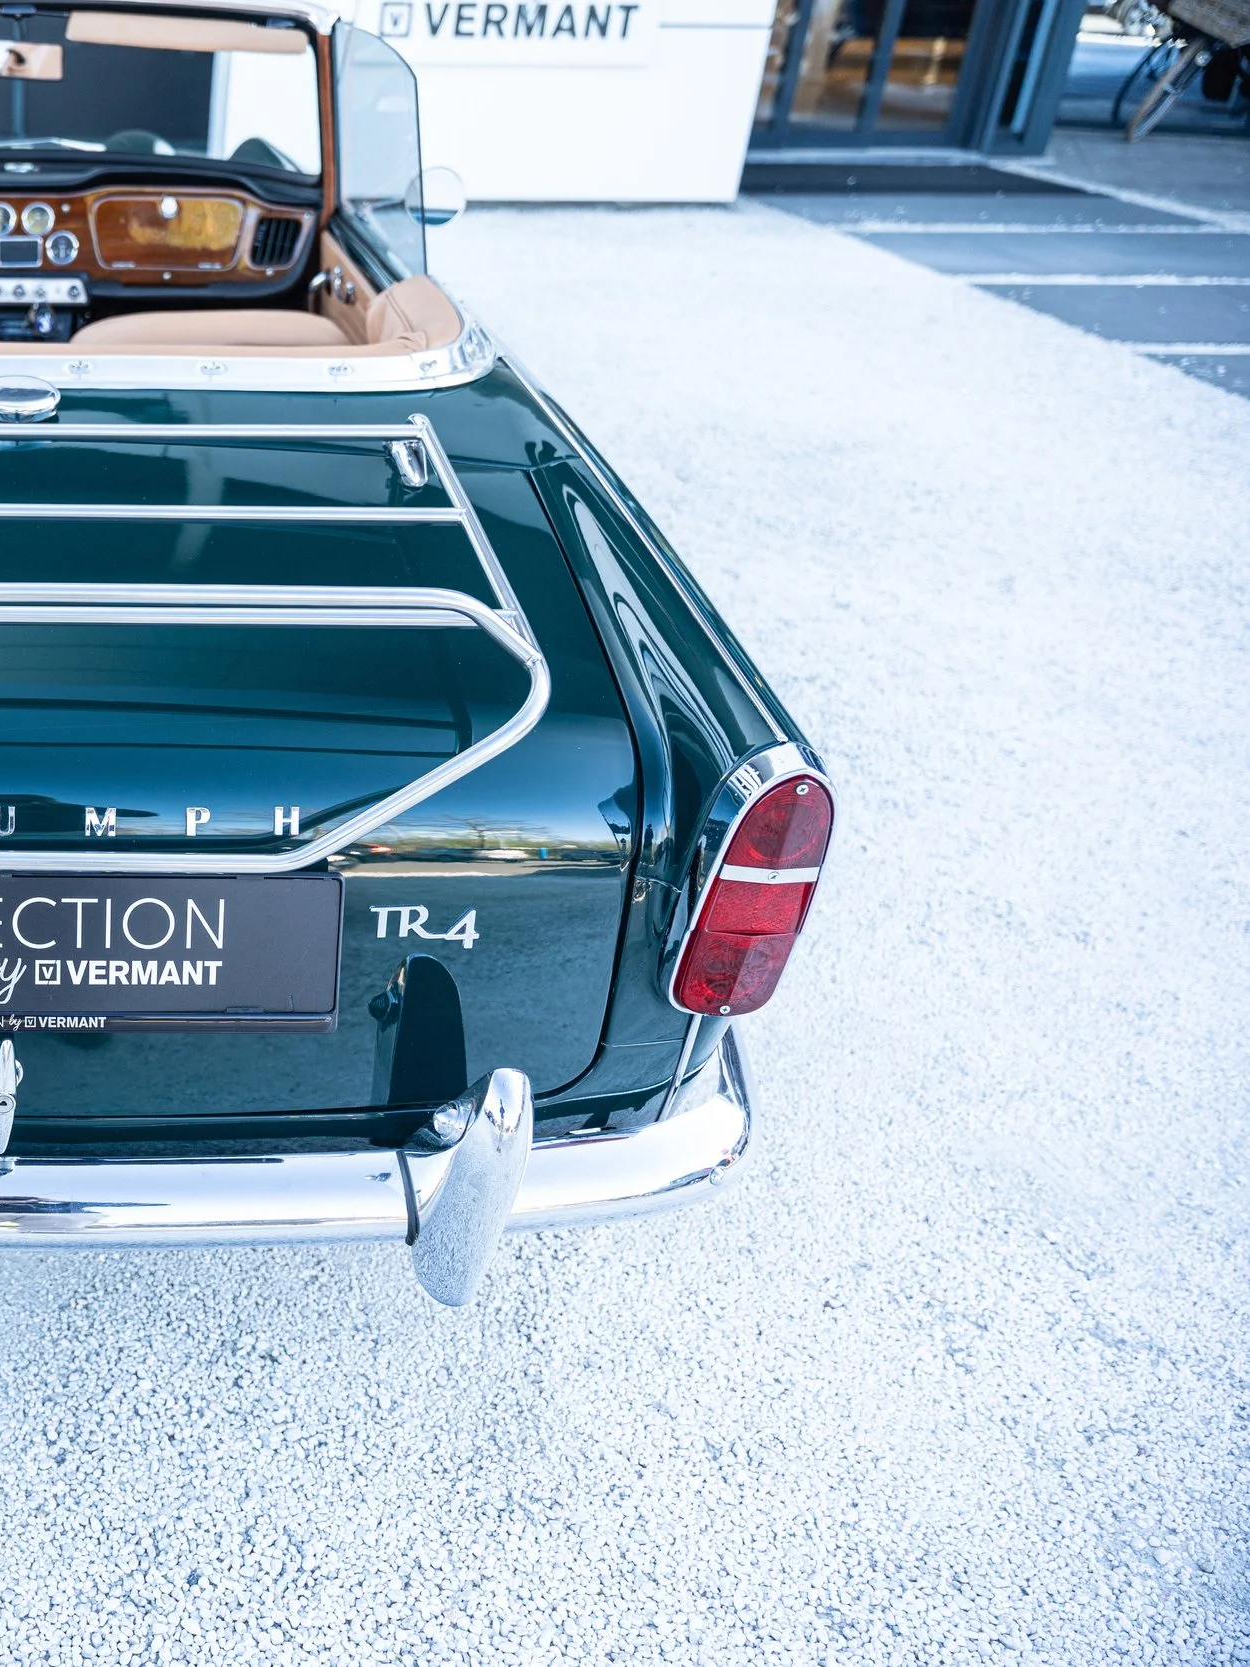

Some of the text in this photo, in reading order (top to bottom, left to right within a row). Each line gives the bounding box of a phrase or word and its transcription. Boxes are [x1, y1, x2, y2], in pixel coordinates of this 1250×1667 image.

[426, 3, 639, 38] VERMANT
[369, 904, 480, 949] TR4
[66, 960, 223, 985] VERMANT
[9, 1014, 22, 1031] by
[39, 1017, 106, 1028] VERMANT
